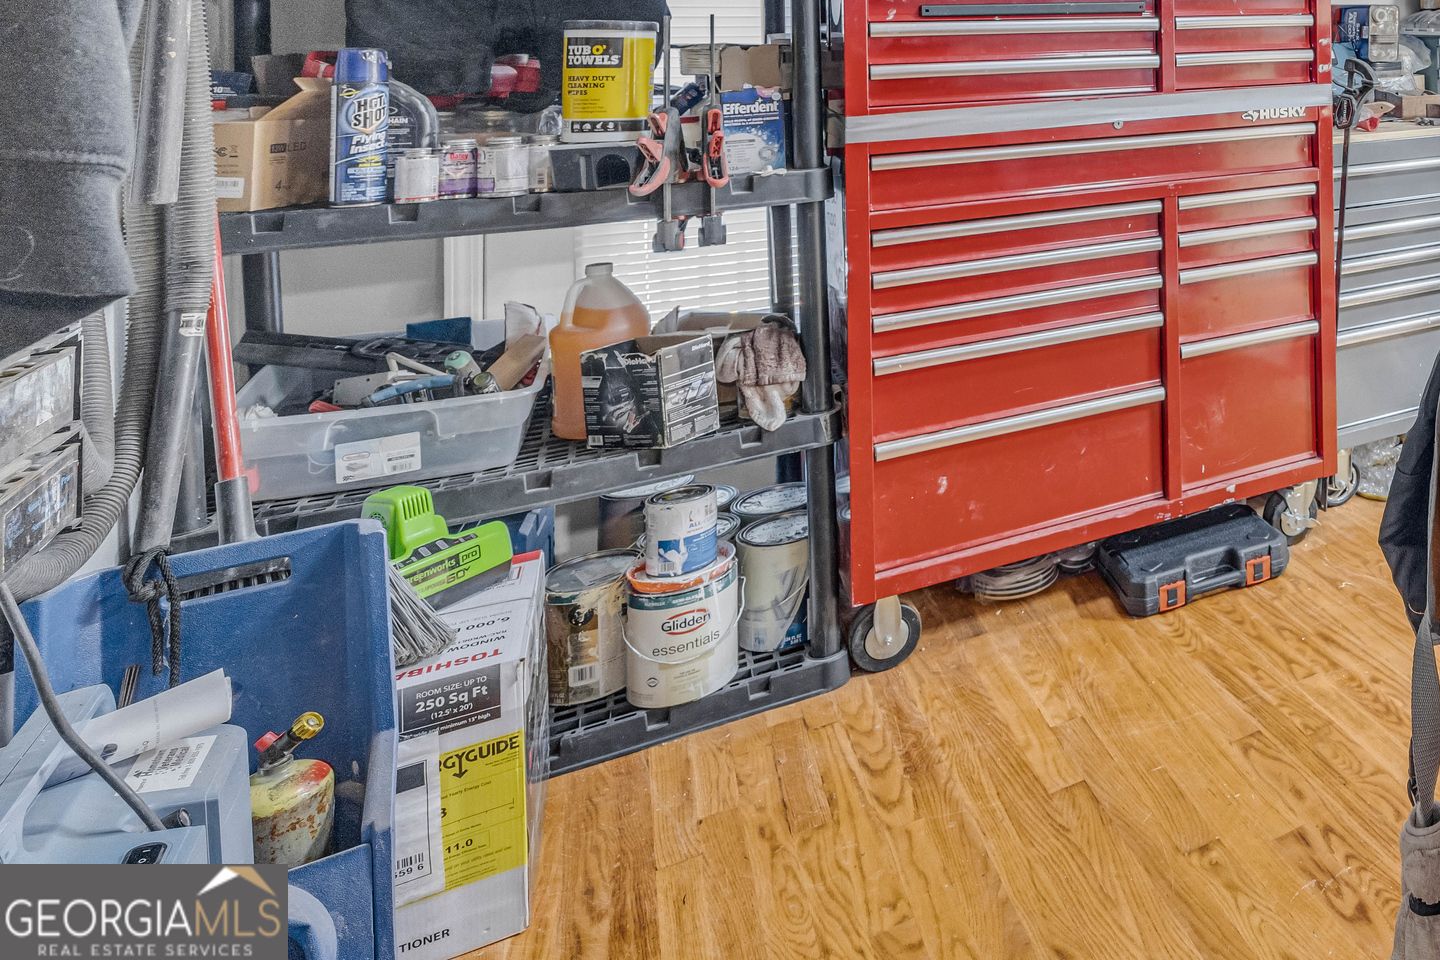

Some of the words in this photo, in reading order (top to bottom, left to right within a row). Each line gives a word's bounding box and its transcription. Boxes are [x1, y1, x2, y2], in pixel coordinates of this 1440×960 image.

[568, 46, 591, 55] TUB
[592, 44, 607, 55] O'
[567, 55, 620, 65] TOWELS
[355, 94, 385, 113] HOT
[722, 101, 779, 115] Efferdent
[352, 106, 386, 129] SHOT
[1259, 106, 1306, 120] HUSKY
[352, 131, 386, 145] Flying
[288, 142, 307, 152] LED
[350, 142, 385, 155] Insect
[461, 548, 478, 563] pro
[466, 616, 510, 631] 6,000
[661, 611, 711, 634] Glidden
[446, 635, 506, 653] WINDOW
[652, 629, 720, 657] essentials
[396, 648, 503, 680] TOSHIBA
[416, 687, 442, 700] ROOM
[443, 683, 463, 693] SIZE:
[464, 679, 475, 687] UP
[476, 675, 487, 683] TO
[415, 697, 445, 713] 250
[448, 691, 469, 704] Sq
[472, 685, 488, 697] Ft
[430, 708, 452, 720] (12.5'
[440, 719, 468, 731] minimum
[477, 712, 491, 721] high
[463, 783, 480, 793] Energy
[445, 838, 473, 854] 11.0
